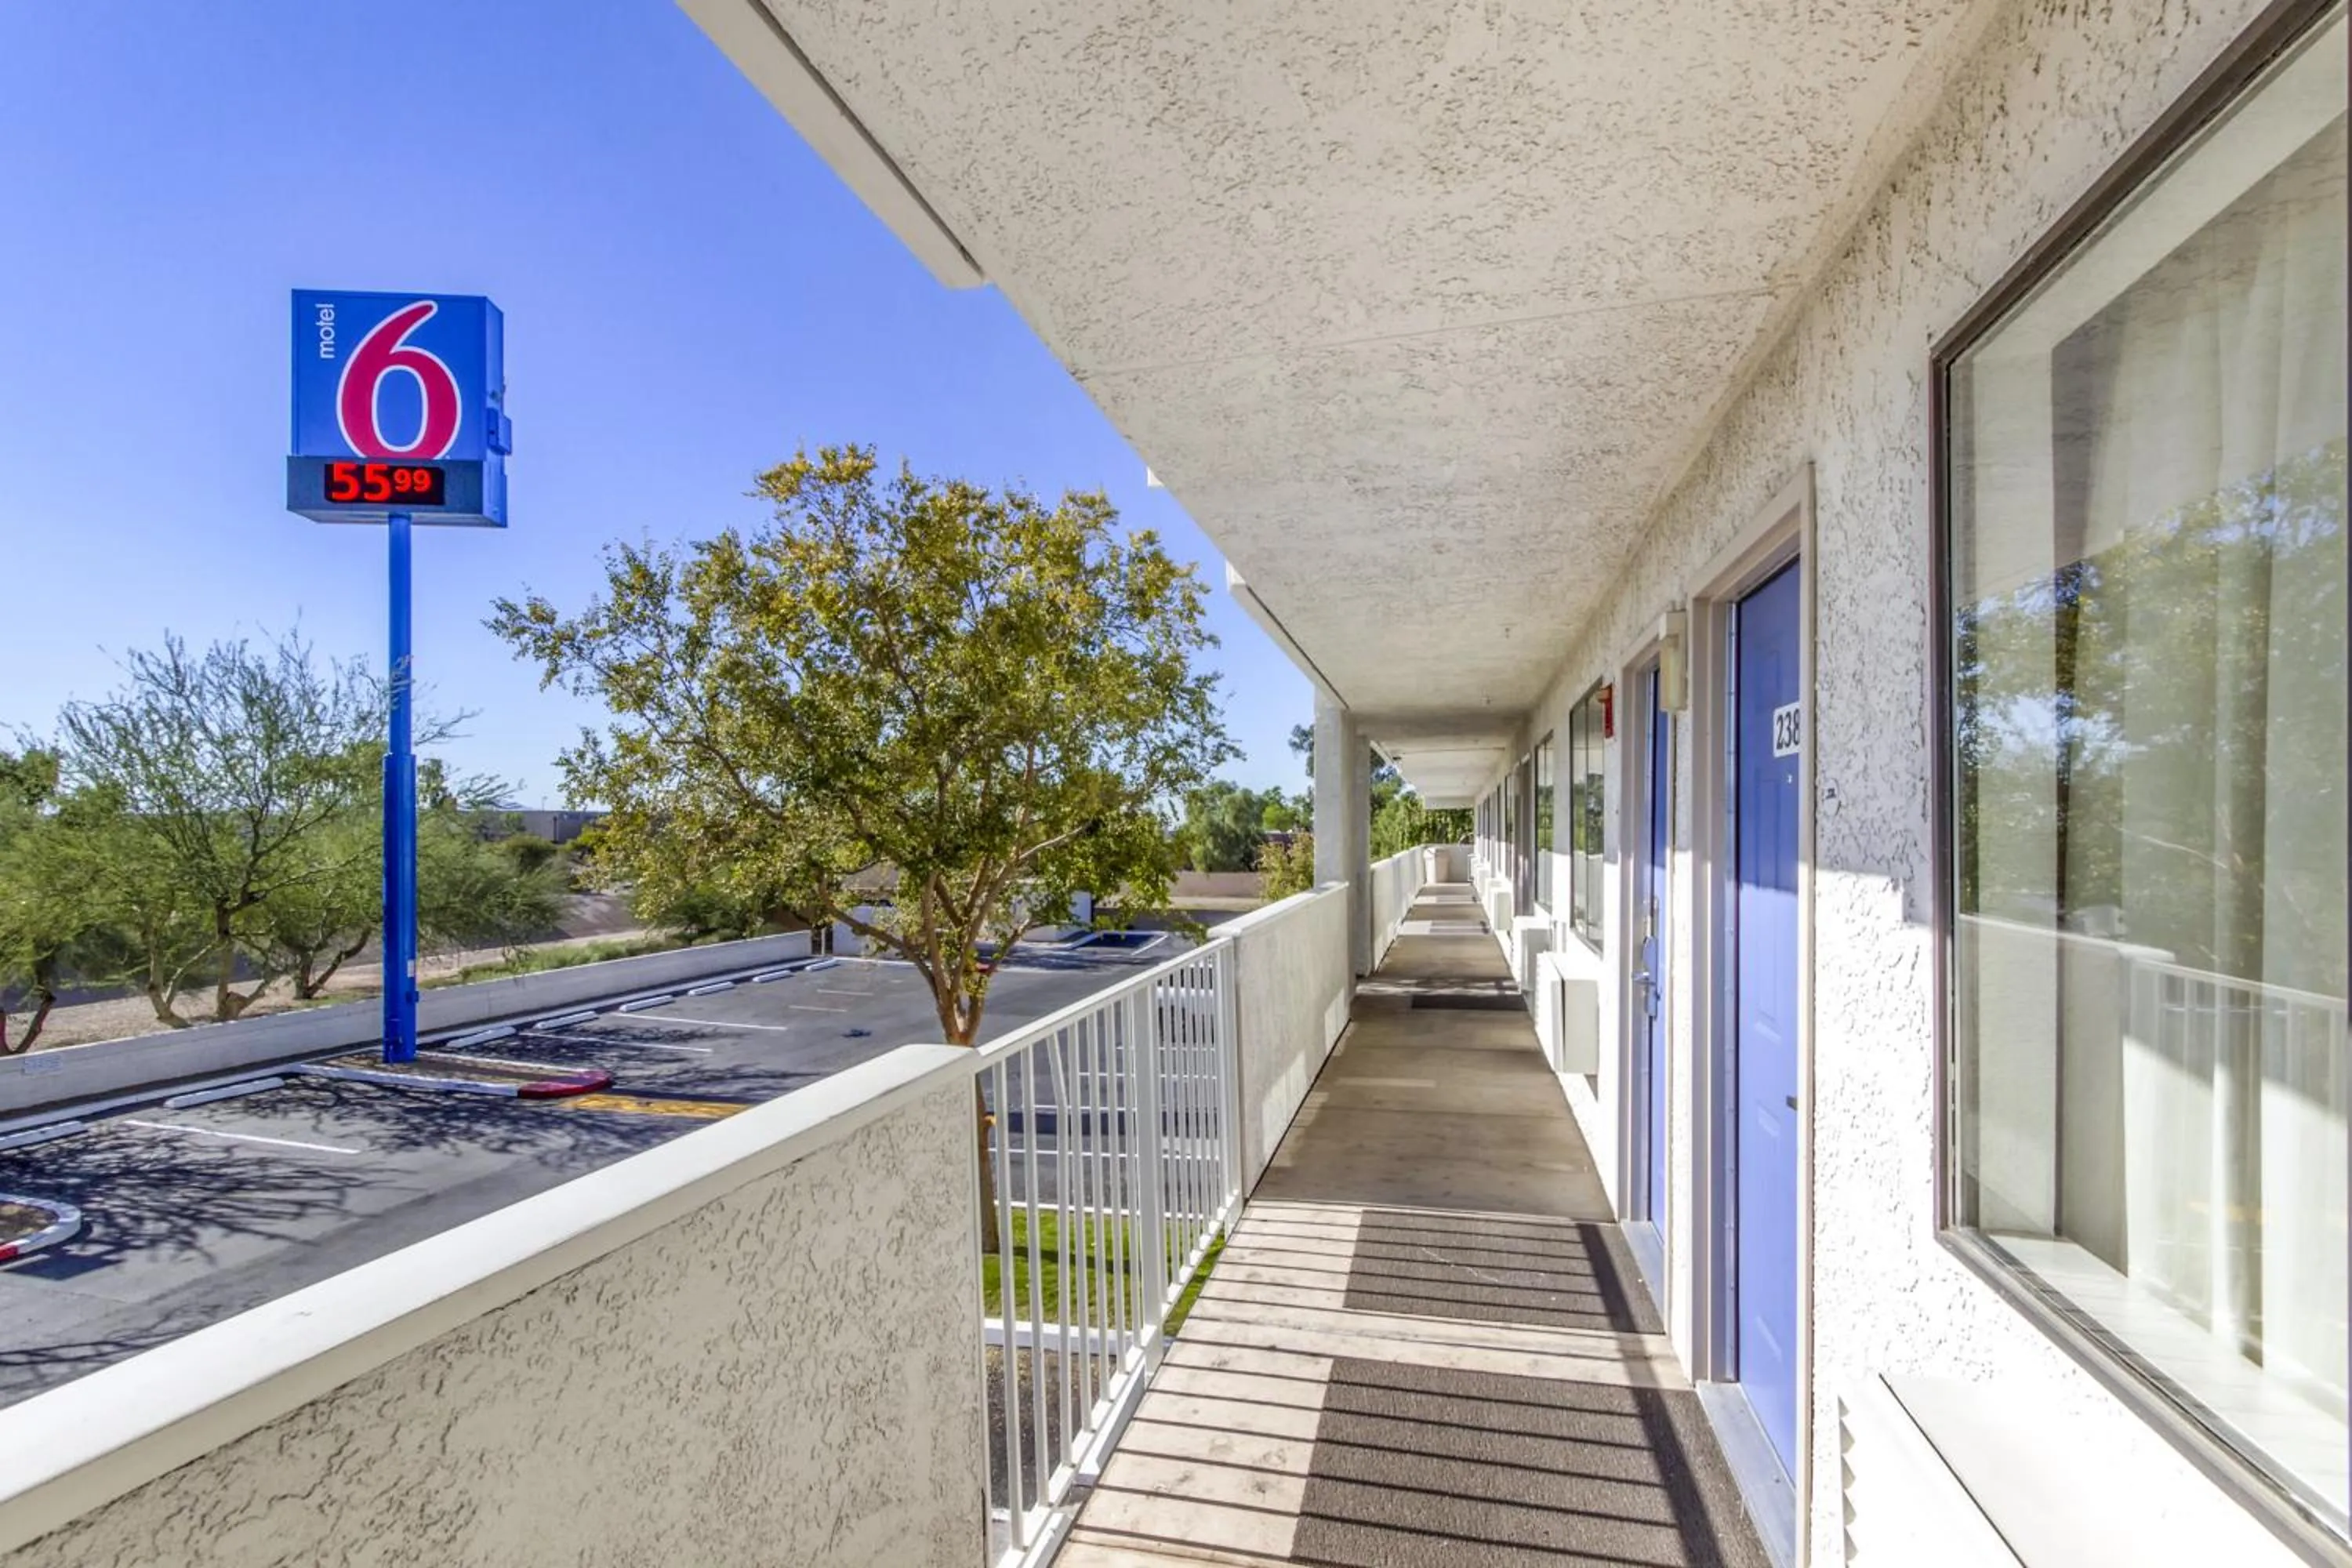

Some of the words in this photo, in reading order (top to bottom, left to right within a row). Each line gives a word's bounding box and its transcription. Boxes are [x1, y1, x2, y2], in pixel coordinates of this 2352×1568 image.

[315, 303, 335, 358] motel
[336, 300, 463, 460] 6
[1776, 708, 1800, 750] 238
